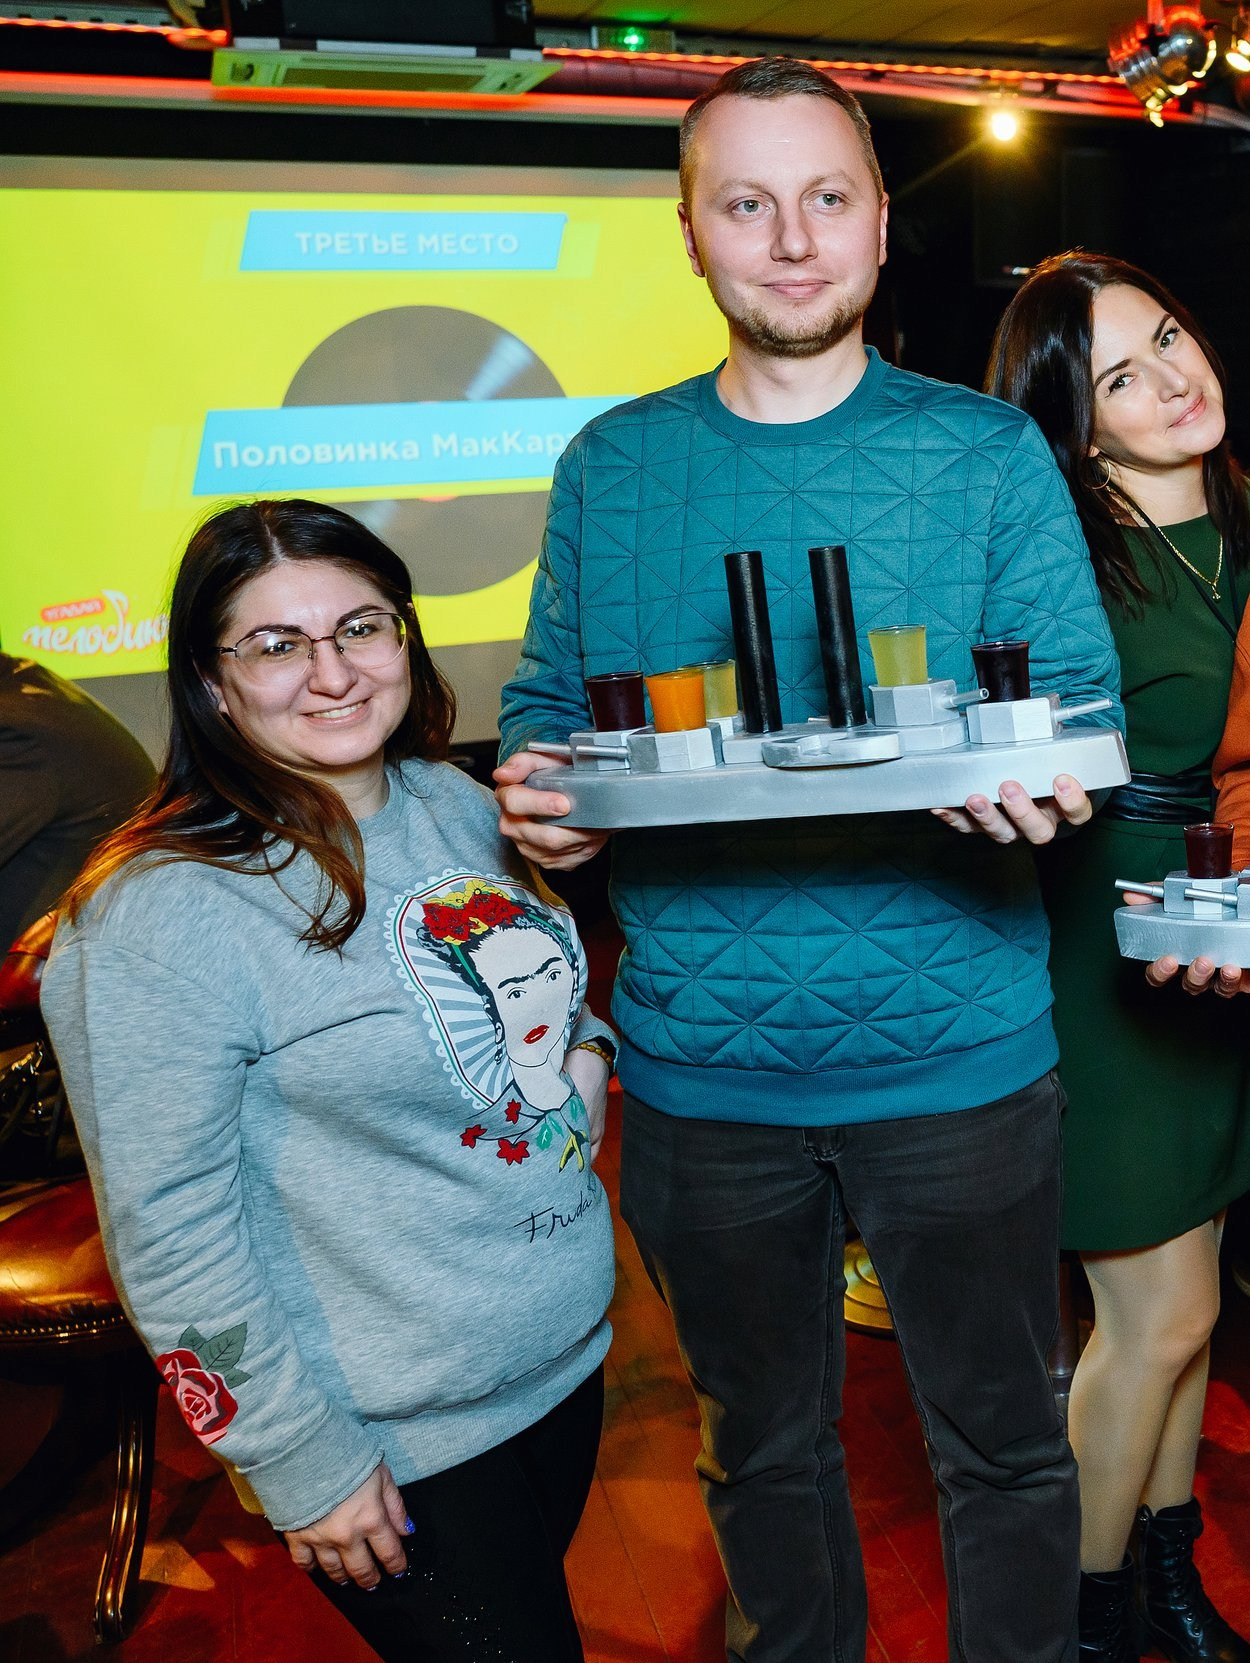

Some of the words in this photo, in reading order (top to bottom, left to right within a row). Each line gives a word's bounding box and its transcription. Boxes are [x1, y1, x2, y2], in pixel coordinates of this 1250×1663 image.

[295, 232, 410, 255] ТРЕТЬЕ
[418, 232, 520, 255] МЕСТО
[213, 438, 420, 469] Половинка
[507, 1191, 592, 1243] Frida
